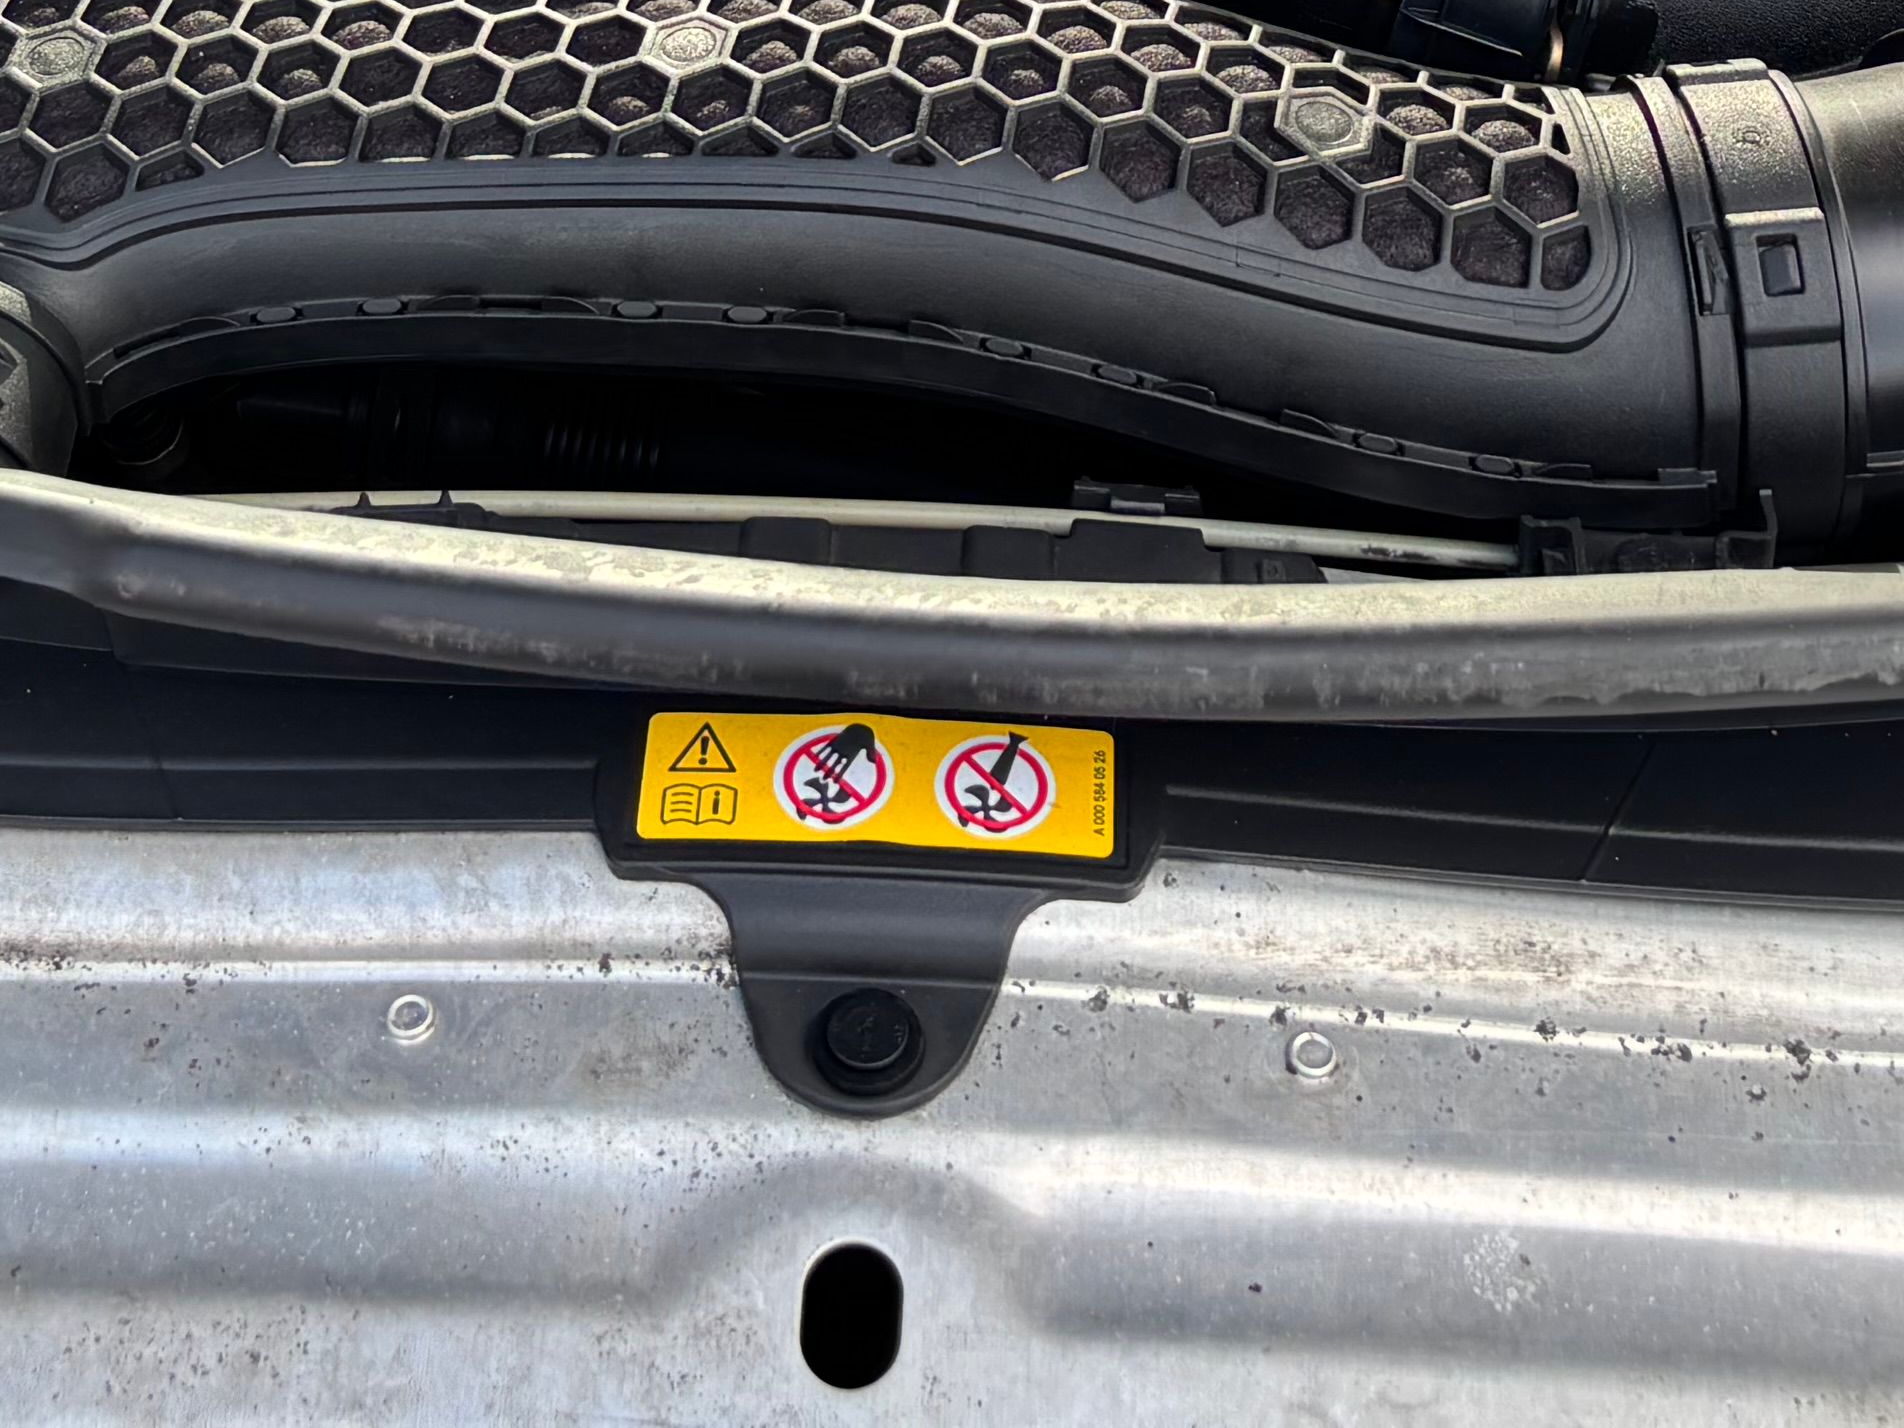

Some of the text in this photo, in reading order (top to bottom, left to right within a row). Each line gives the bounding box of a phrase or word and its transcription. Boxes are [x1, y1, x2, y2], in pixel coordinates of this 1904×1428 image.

[1093, 749, 1106, 836] A 000 584 05 26
